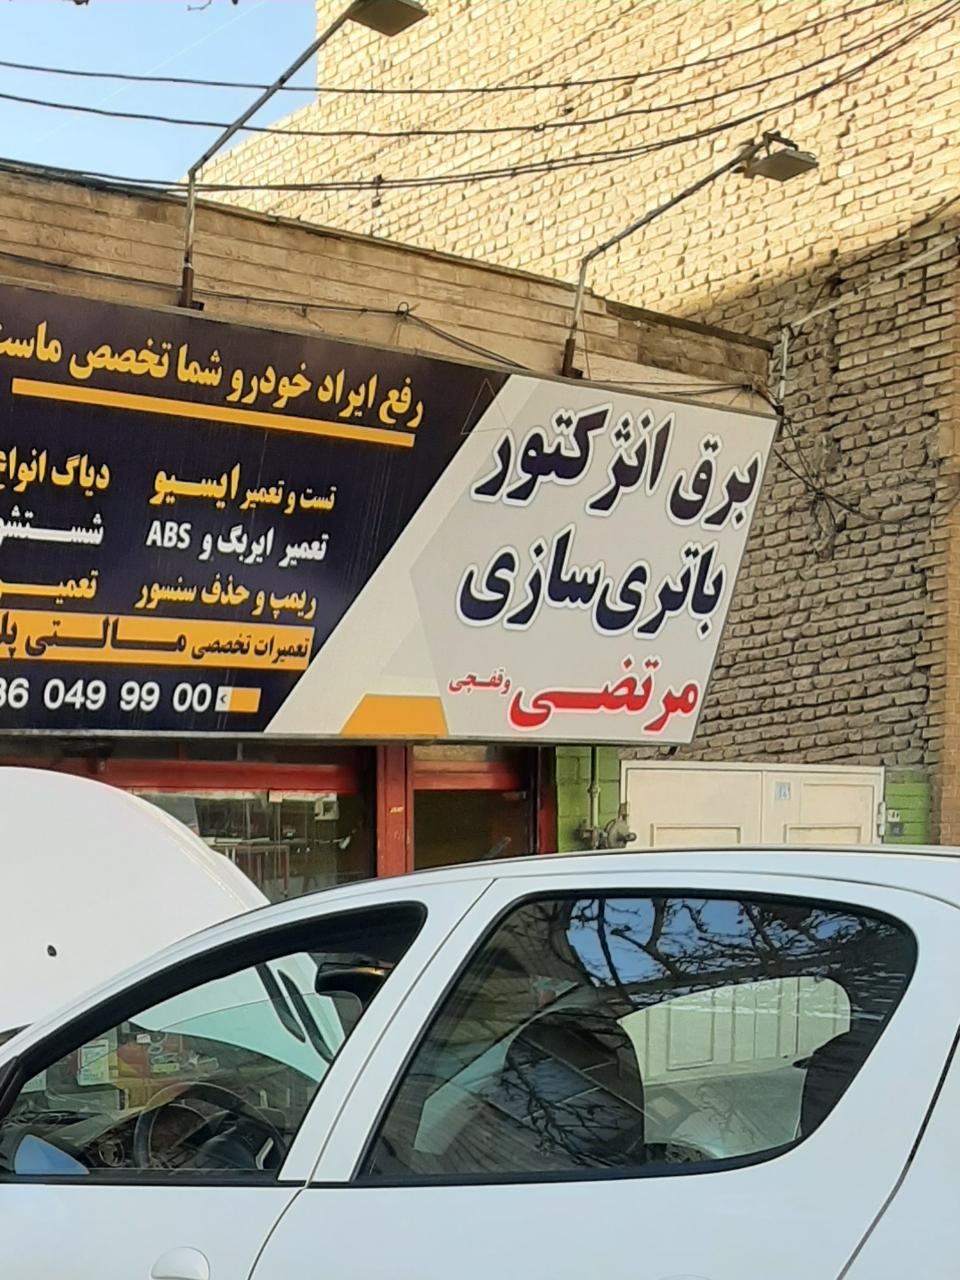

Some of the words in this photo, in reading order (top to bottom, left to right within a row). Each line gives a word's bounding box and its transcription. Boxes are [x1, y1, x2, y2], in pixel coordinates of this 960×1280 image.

[68, 338, 169, 380] تخصص
[177, 344, 222, 386] شما
[226, 363, 312, 407] خودرو
[317, 369, 377, 417] ایراد
[378, 376, 425, 427] رفع
[50, 454, 111, 496] دیاگ
[473, 405, 675, 517] انژکتور
[149, 463, 241, 509] ایسیو
[239, 479, 286, 510] تعمیر
[299, 486, 337, 510] تست
[668, 434, 763, 532] برق
[283, 489, 296, 514] و
[146, 520, 191, 550] ABS
[199, 535, 212, 560] و
[216, 521, 275, 560] ایربگ
[278, 532, 329, 568] تعمیر
[134, 576, 197, 609] سنسور
[200, 572, 250, 607] حذف
[251, 590, 265, 617] و
[268, 589, 317, 621] ریمپ
[24, 616, 186, 657] مالتی
[190, 633, 252, 660] تخصصی
[253, 635, 310, 665] تعمیرات
[43, 679, 107, 711] 049
[119, 681, 160, 711] 99
[172, 683, 212, 713] 00
[508, 656, 700, 733] مرتضی
